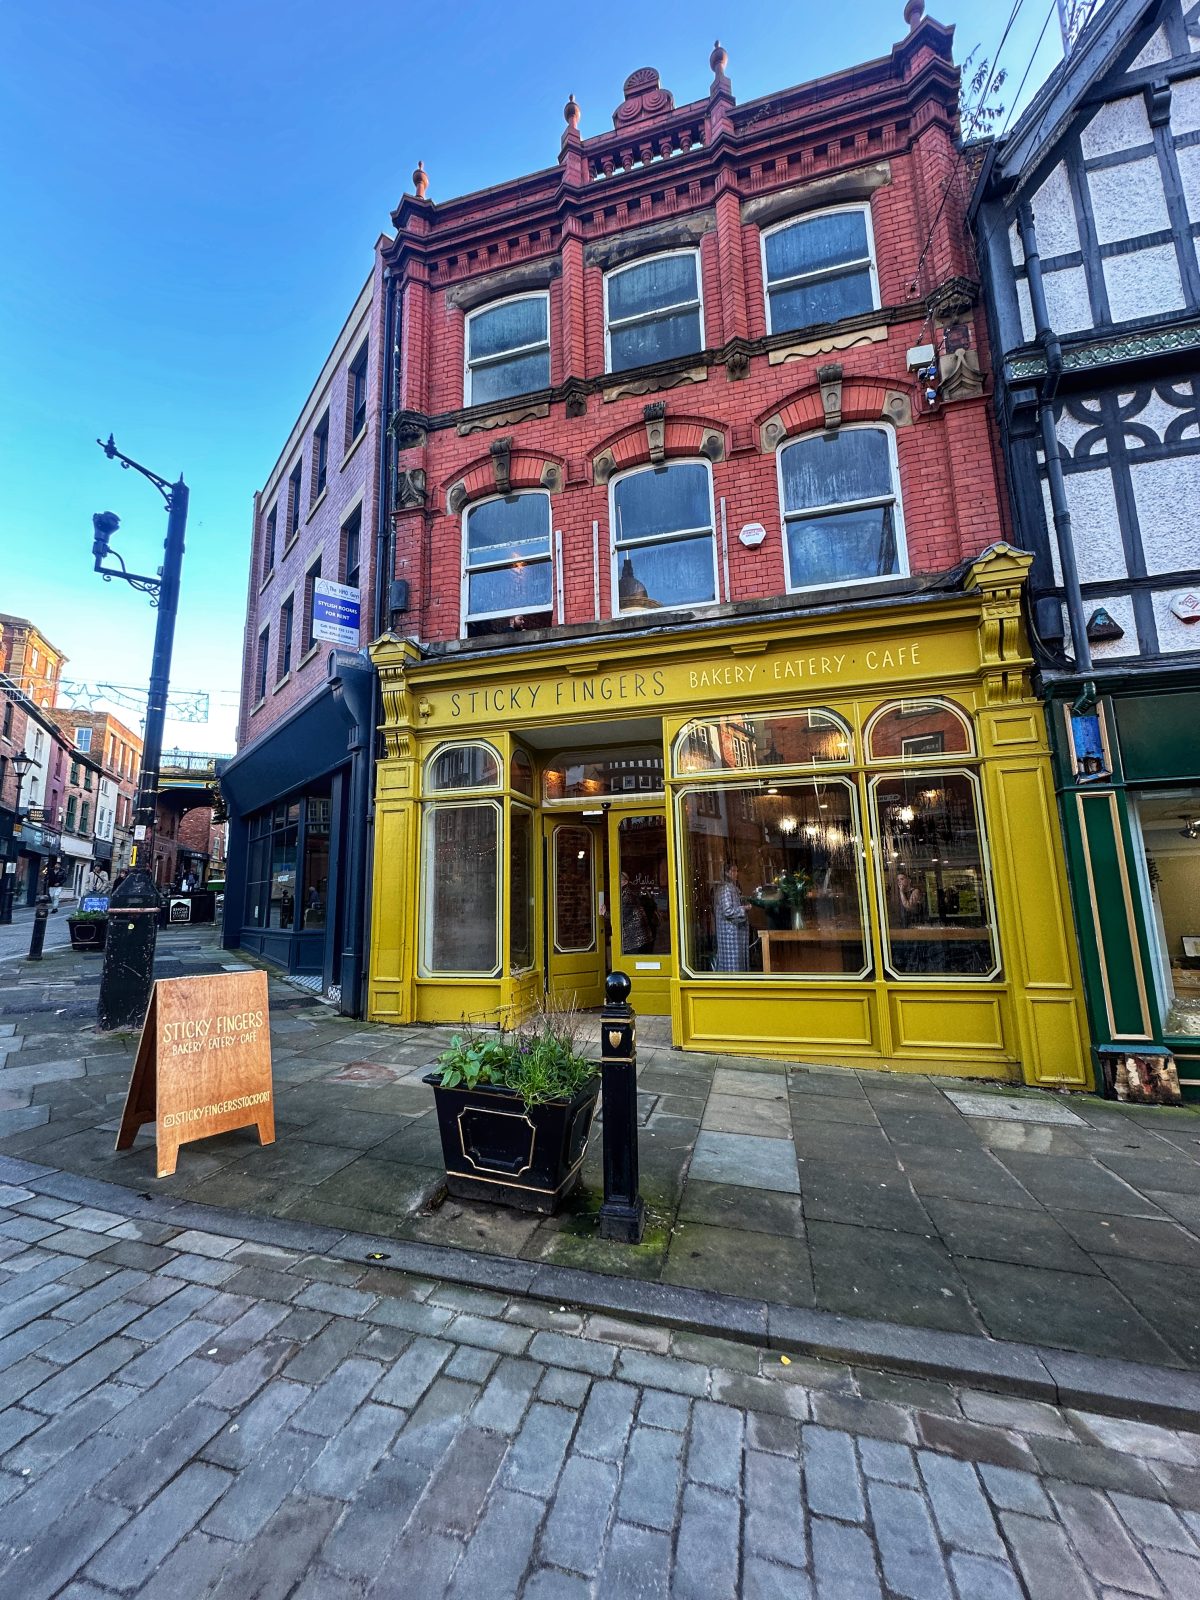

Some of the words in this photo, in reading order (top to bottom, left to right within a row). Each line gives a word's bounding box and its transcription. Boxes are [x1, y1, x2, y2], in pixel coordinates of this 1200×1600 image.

[318, 601, 338, 609] STYLISH
[339, 606, 358, 614] ROOMS
[336, 613, 350, 621] RENT
[690, 663, 757, 689] BAKERY
[774, 654, 846, 680] EATERY
[865, 643, 921, 670] CAFÉ
[451, 684, 541, 717] STICKY
[555, 670, 666, 705] FINGERS
[163, 1018, 212, 1043] STICKY
[217, 1010, 263, 1034] FINGERS
[172, 1041, 204, 1057] BAKERY
[208, 1035, 237, 1050] EATERY
